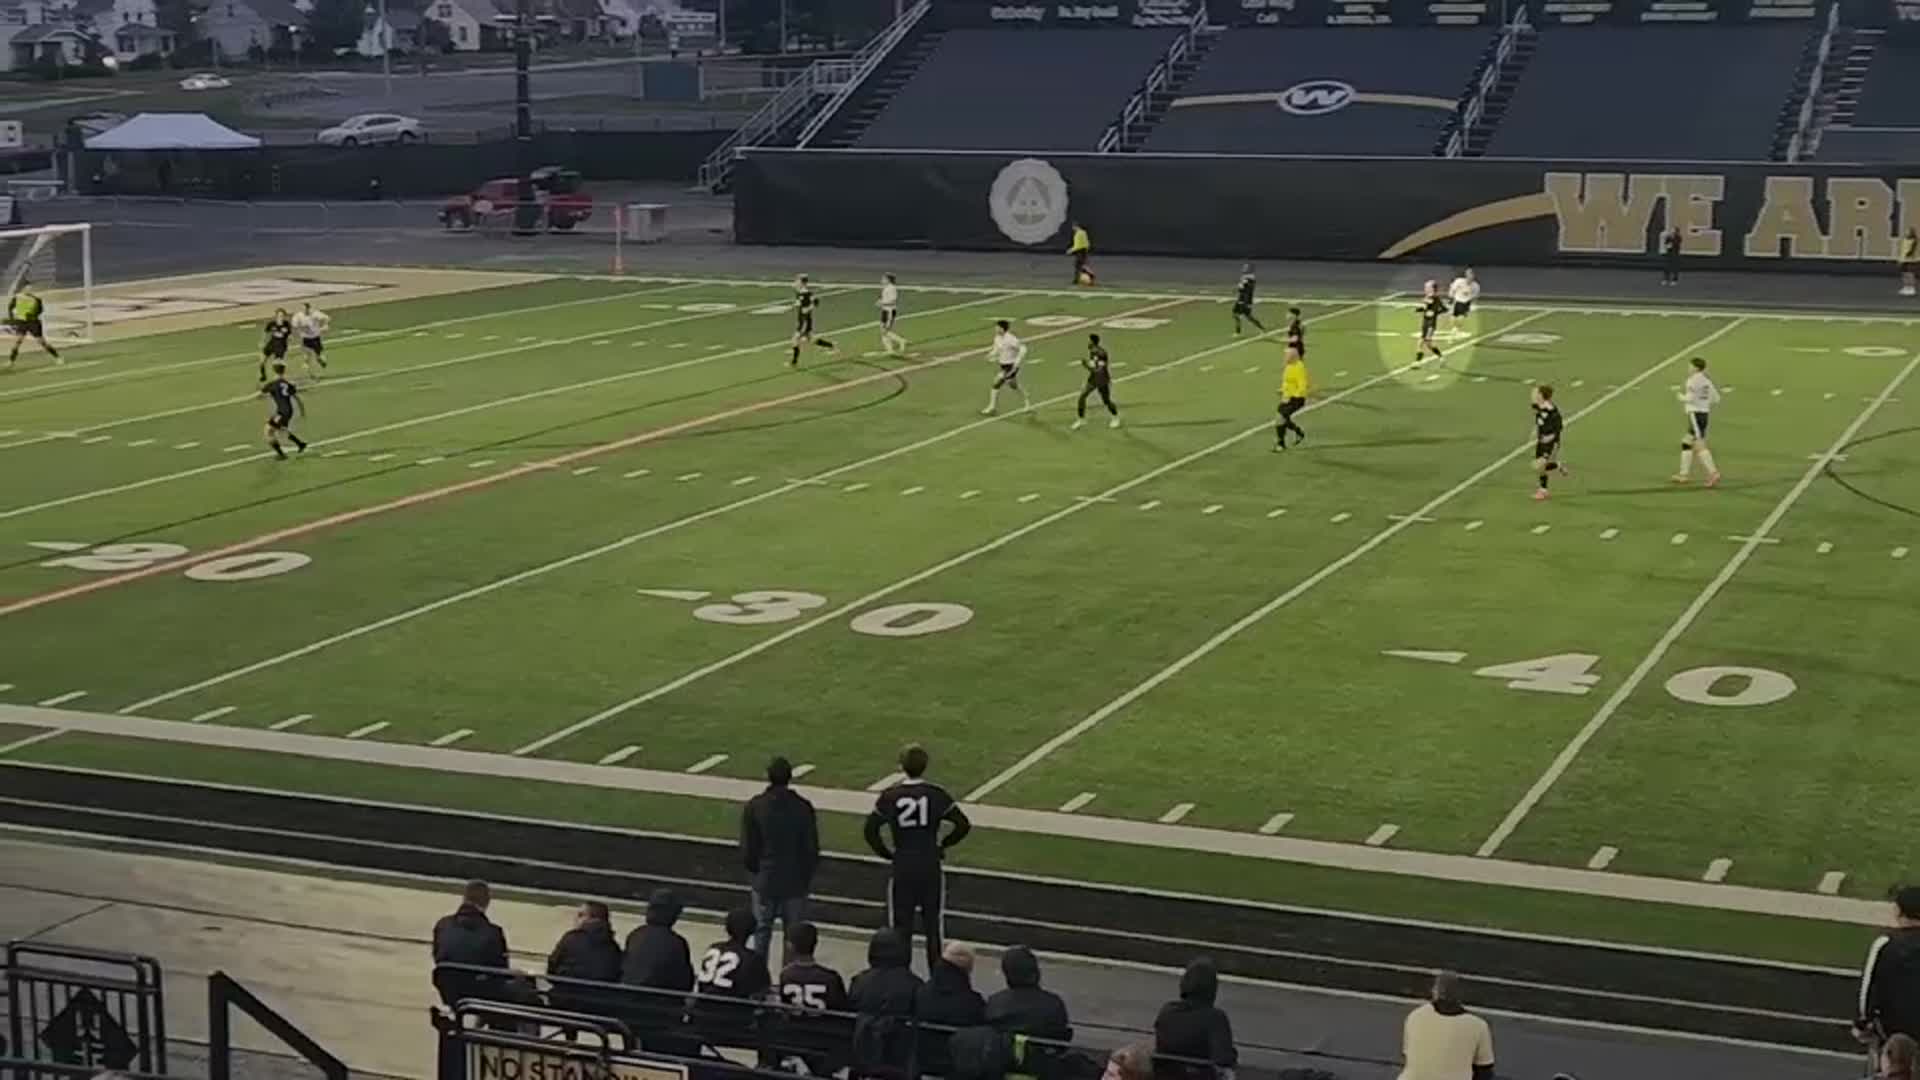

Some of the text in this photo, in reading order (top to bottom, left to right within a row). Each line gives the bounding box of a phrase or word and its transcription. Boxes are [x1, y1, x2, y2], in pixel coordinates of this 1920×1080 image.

[1544, 172, 1725, 256] WE
[1472, 652, 1799, 706] 40
[896, 795, 929, 828] 21
[697, 947, 741, 988] 32
[782, 983, 828, 1014] 35
[480, 1054, 523, 1080] NO
